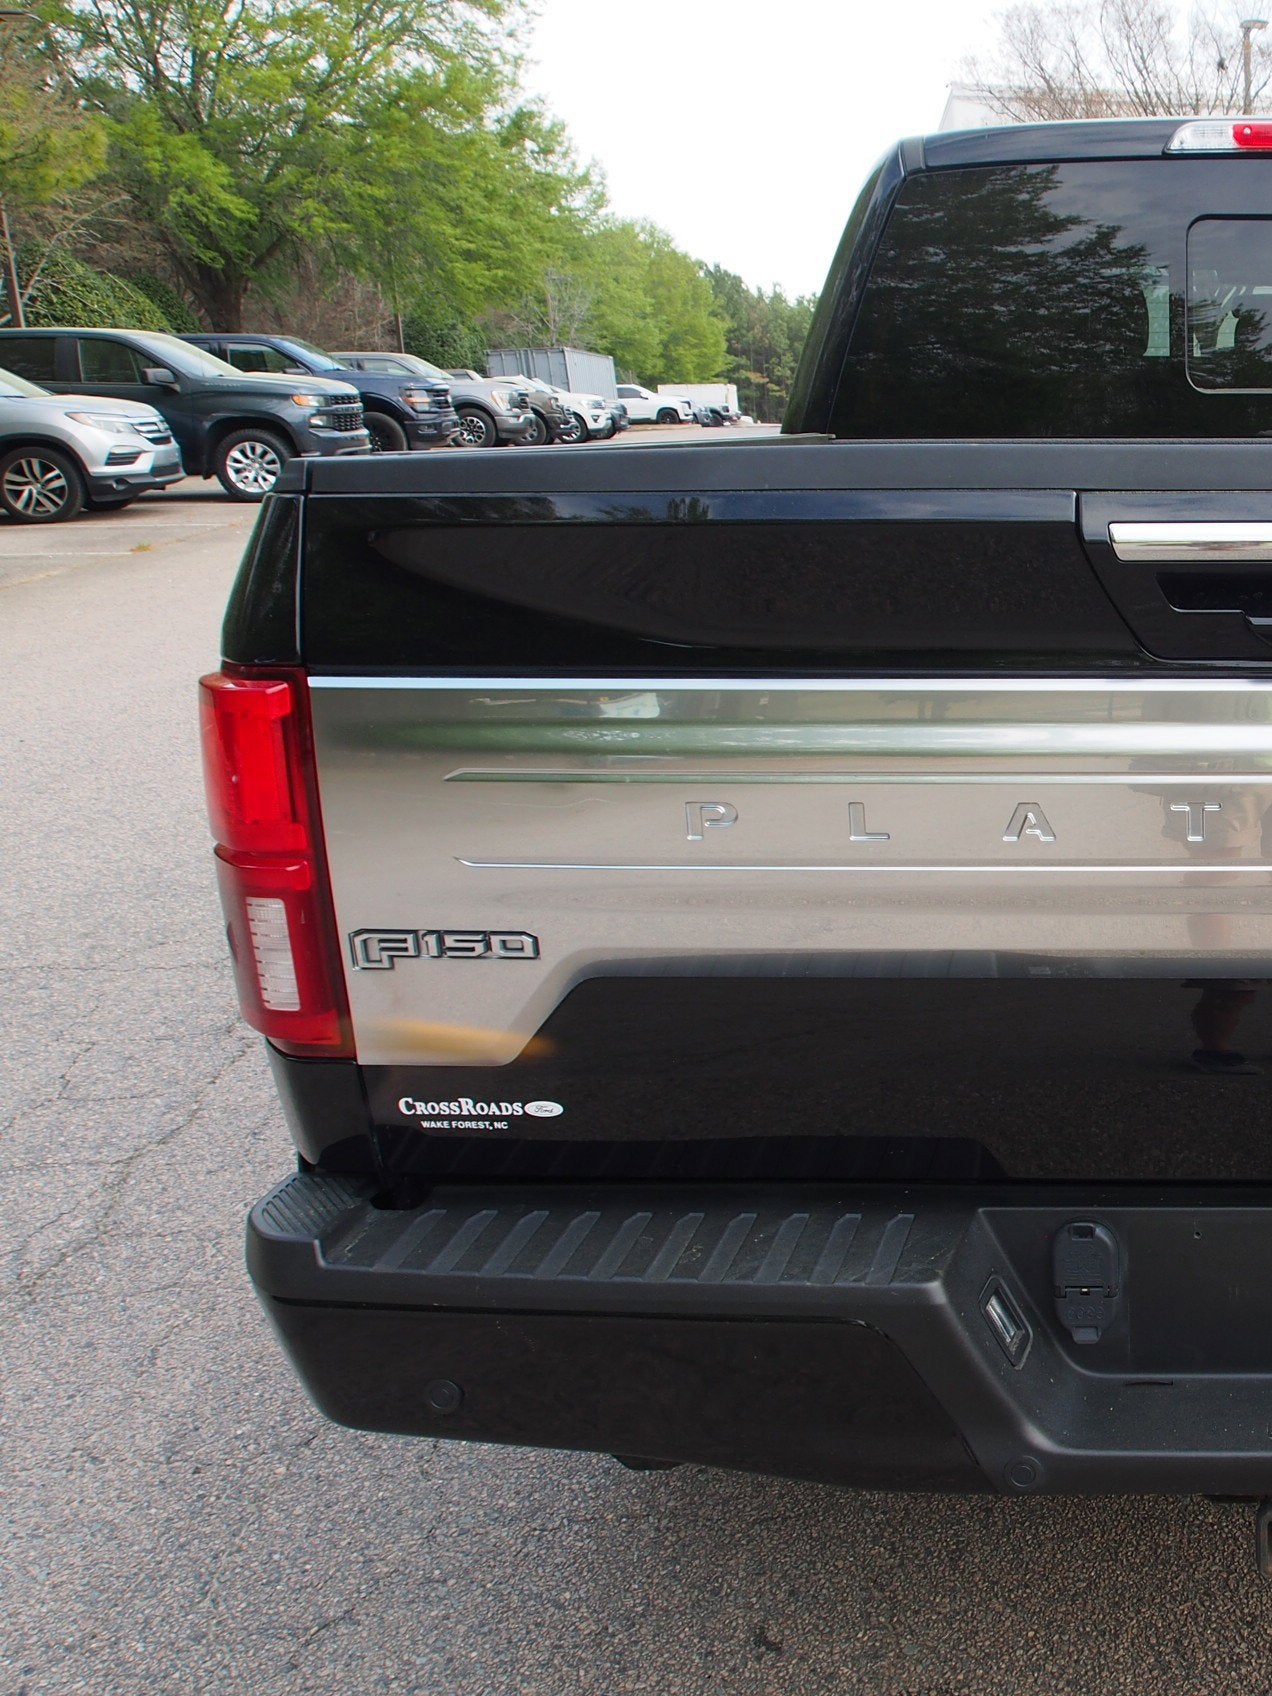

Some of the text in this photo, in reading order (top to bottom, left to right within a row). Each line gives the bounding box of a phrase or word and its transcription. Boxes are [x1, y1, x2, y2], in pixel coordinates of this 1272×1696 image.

[420, 1120, 508, 1130] WAKE FOREST, NC
